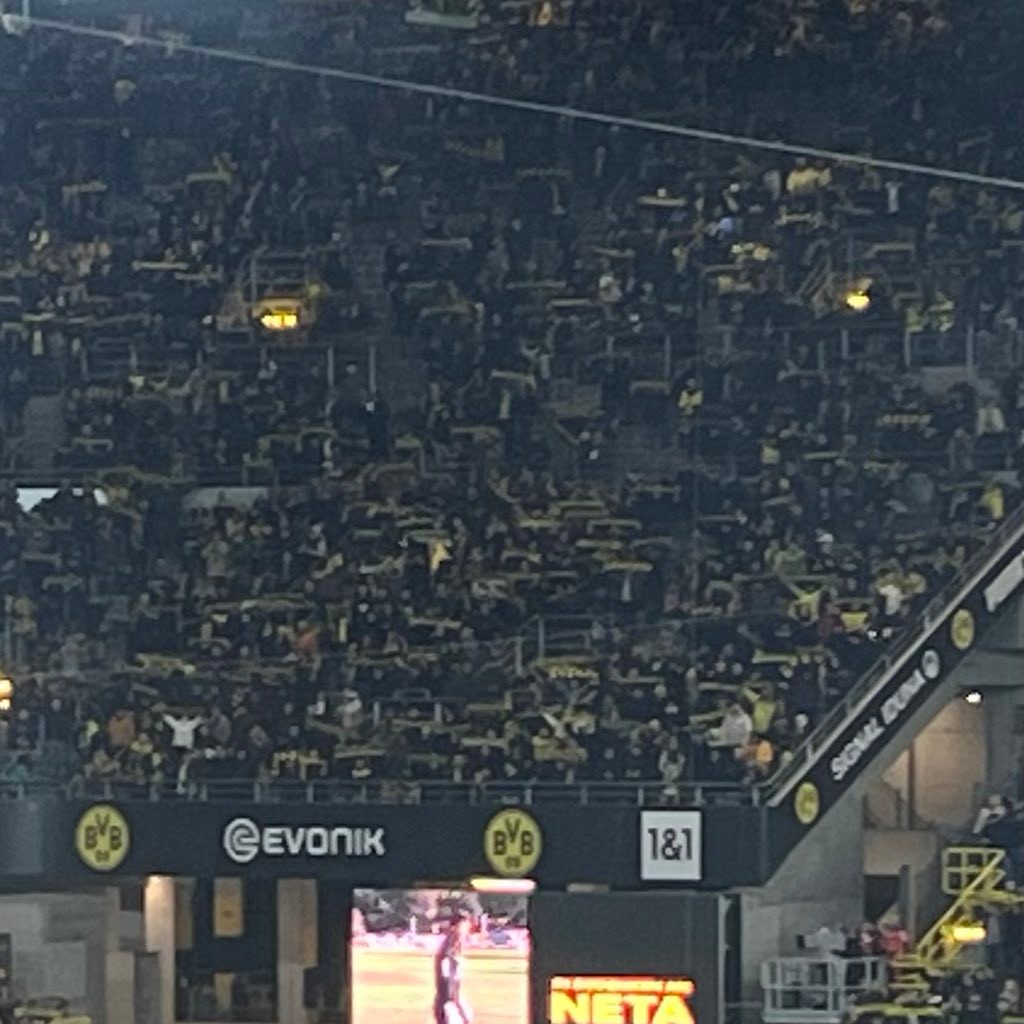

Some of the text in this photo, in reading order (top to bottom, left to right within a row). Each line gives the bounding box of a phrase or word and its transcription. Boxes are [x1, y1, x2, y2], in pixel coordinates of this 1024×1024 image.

[84, 813, 123, 850] BVB
[262, 827, 386, 856] EVONIK
[492, 818, 536, 856] BVB
[647, 827, 693, 861] 1&1
